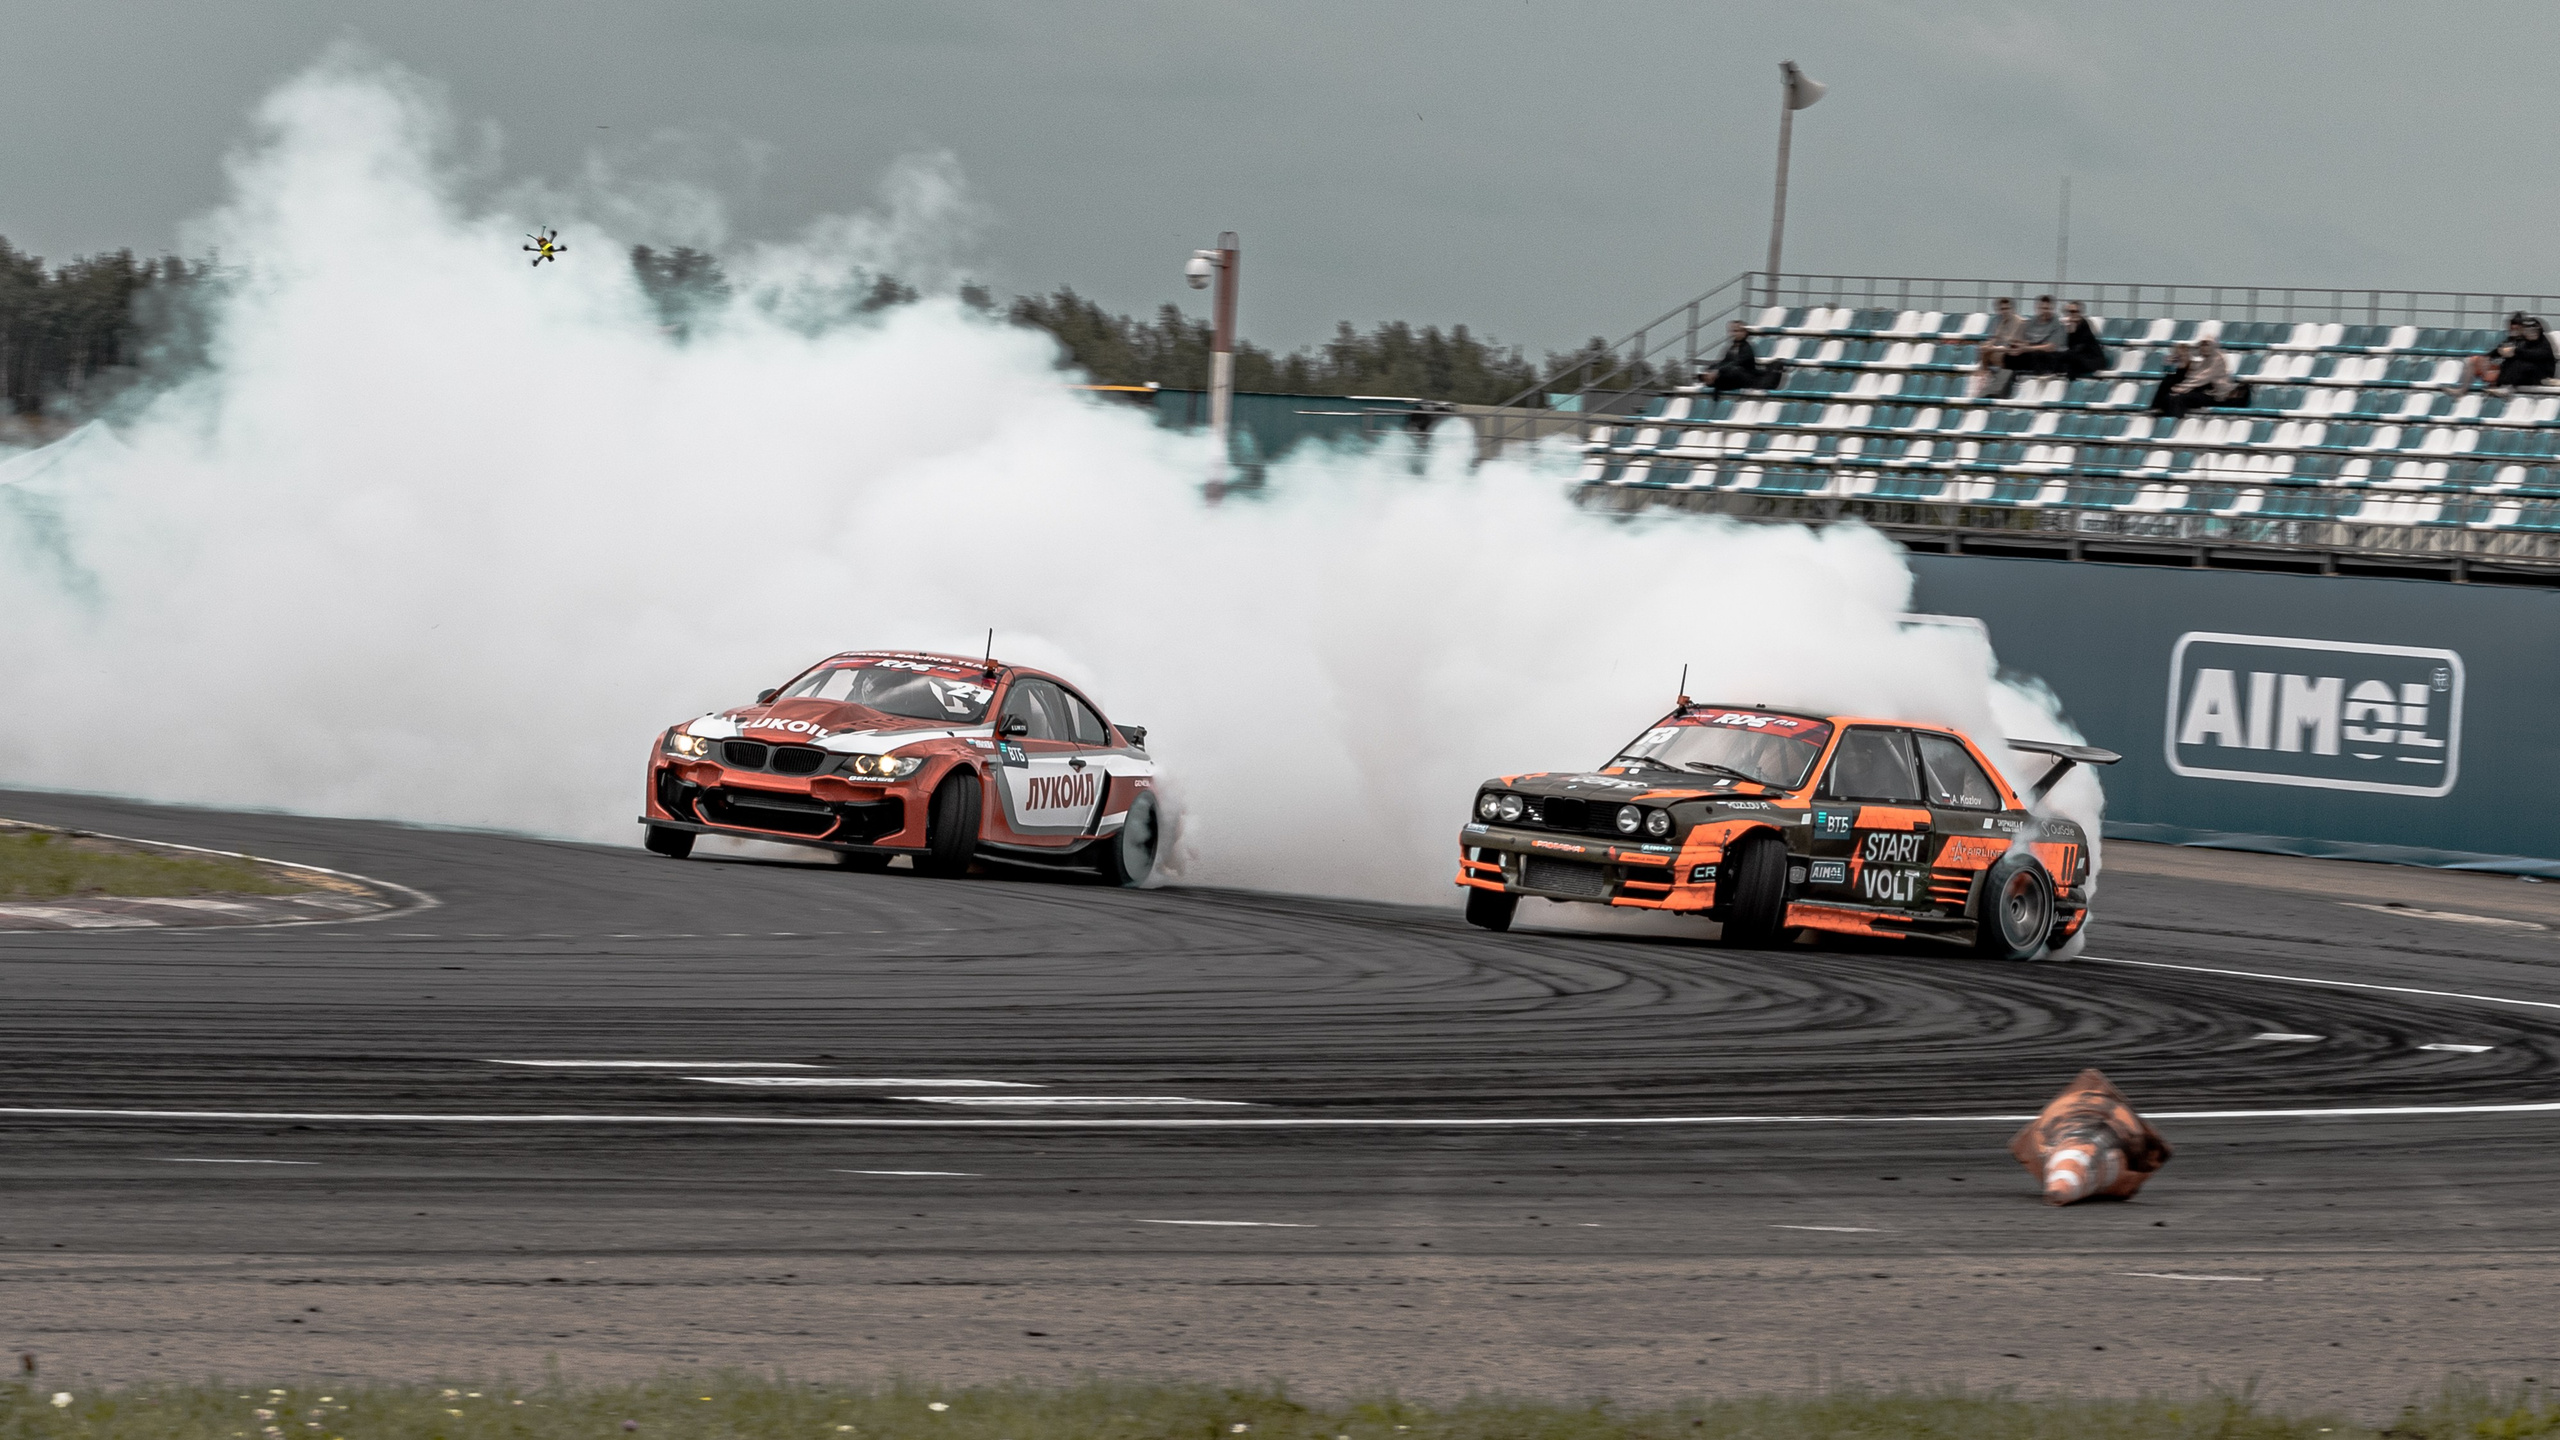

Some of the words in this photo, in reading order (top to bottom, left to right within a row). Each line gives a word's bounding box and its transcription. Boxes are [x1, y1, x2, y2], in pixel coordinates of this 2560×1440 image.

[874, 659, 937, 671] RDS
[943, 681, 994, 705] 21
[1713, 713, 1776, 728] RDS
[2179, 668, 2445, 764] AIMOL
[1635, 726, 1680, 746] 13
[1007, 746, 1026, 762] ВТБ
[849, 775, 895, 783] GENESIS
[1025, 766, 1095, 811] ЛУКОЙЛ
[1960, 794, 1982, 805] Kozlov
[1827, 815, 1849, 833] ВТБ
[1865, 832, 1925, 862] START
[1811, 866, 1842, 879] AIMOL
[1863, 868, 1920, 902] VOLT
